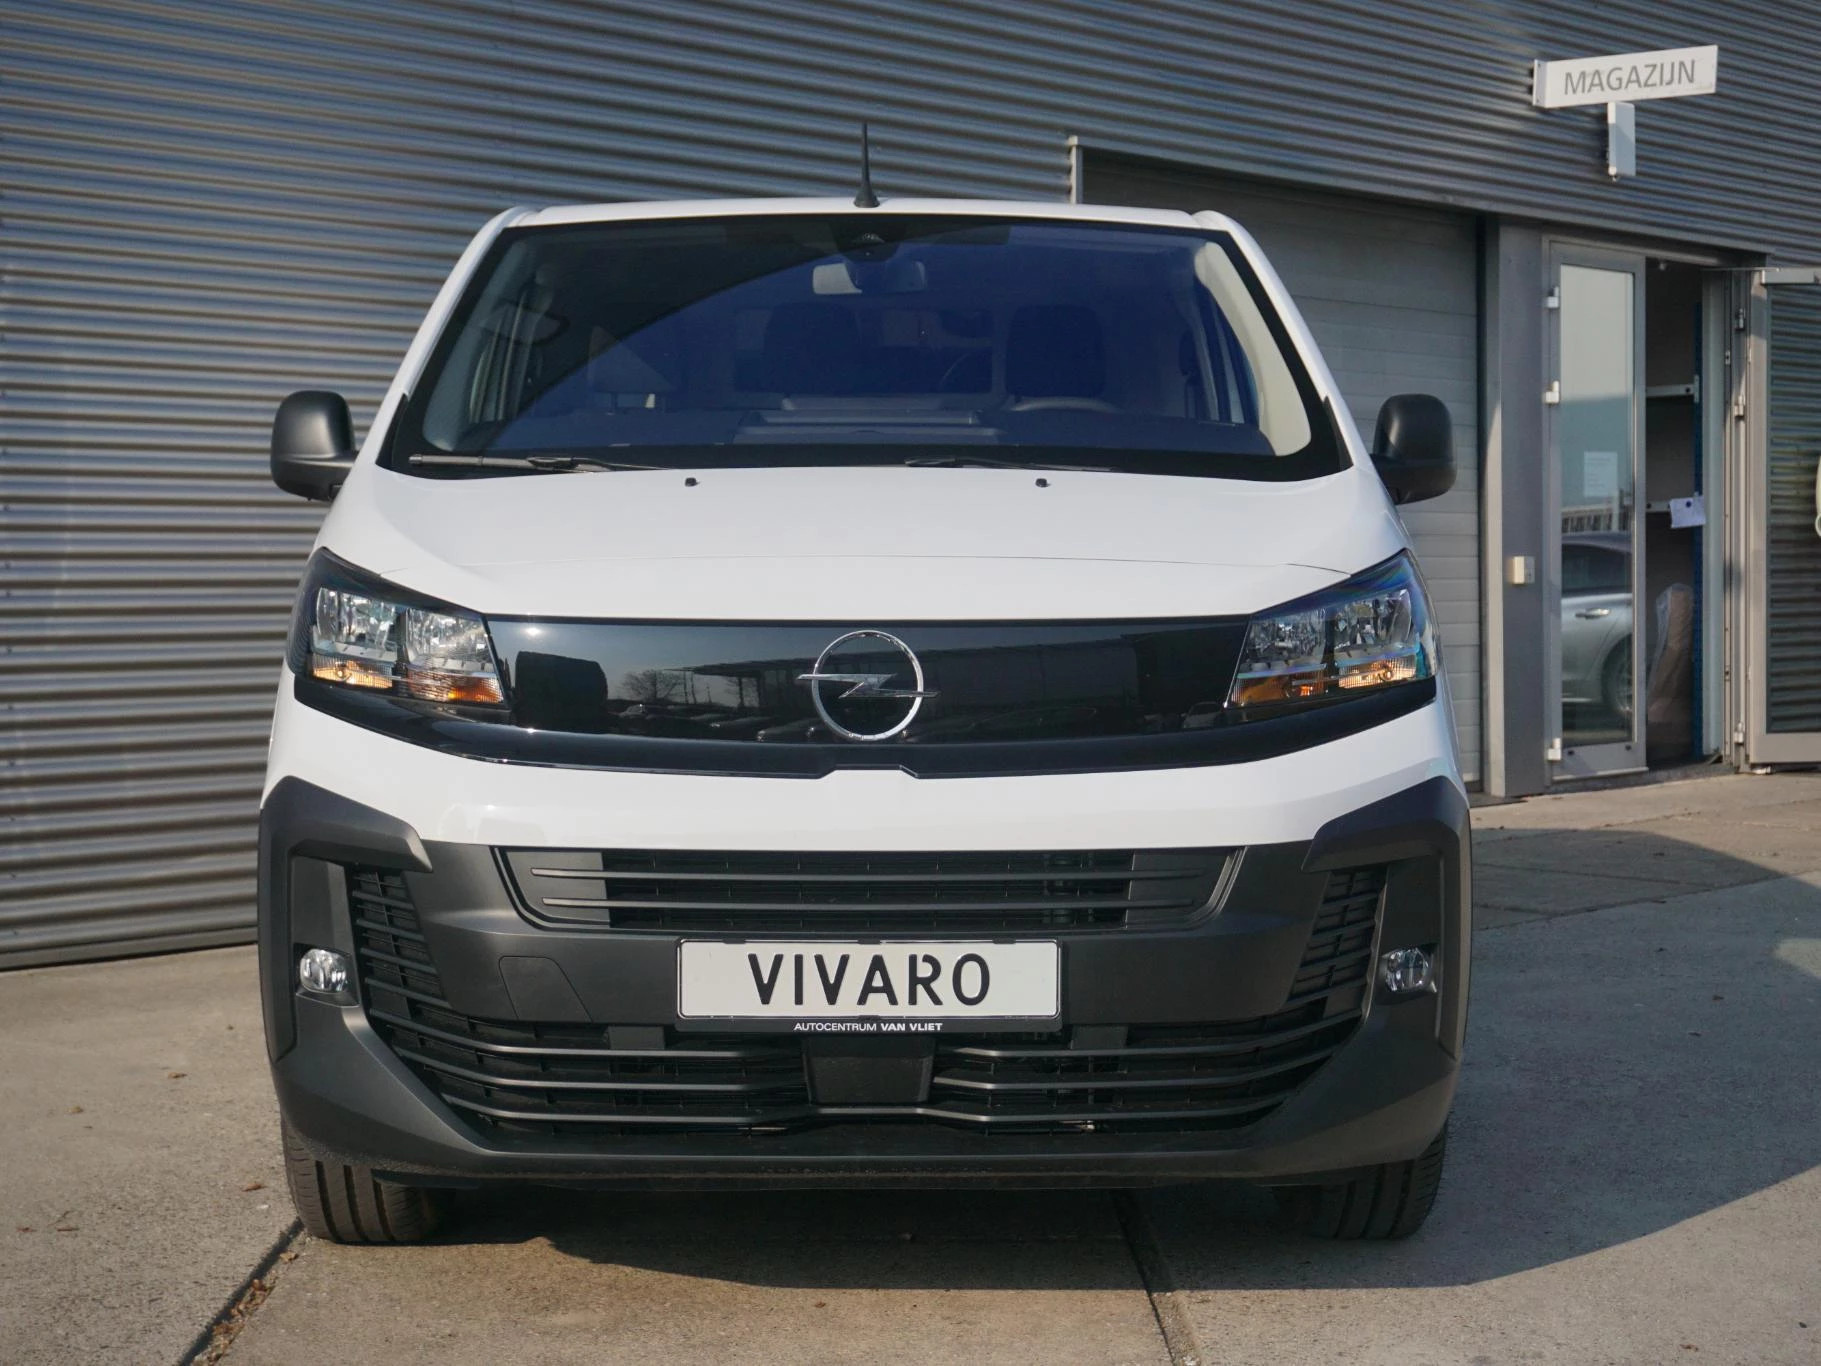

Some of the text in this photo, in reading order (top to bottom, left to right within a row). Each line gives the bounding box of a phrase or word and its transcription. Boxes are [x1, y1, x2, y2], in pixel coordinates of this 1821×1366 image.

[1563, 59, 1696, 96] MAGAZIJN
[747, 953, 990, 1006] VIVARO
[793, 1022, 943, 1032] AUTOCENTRUM VAN VLIET
